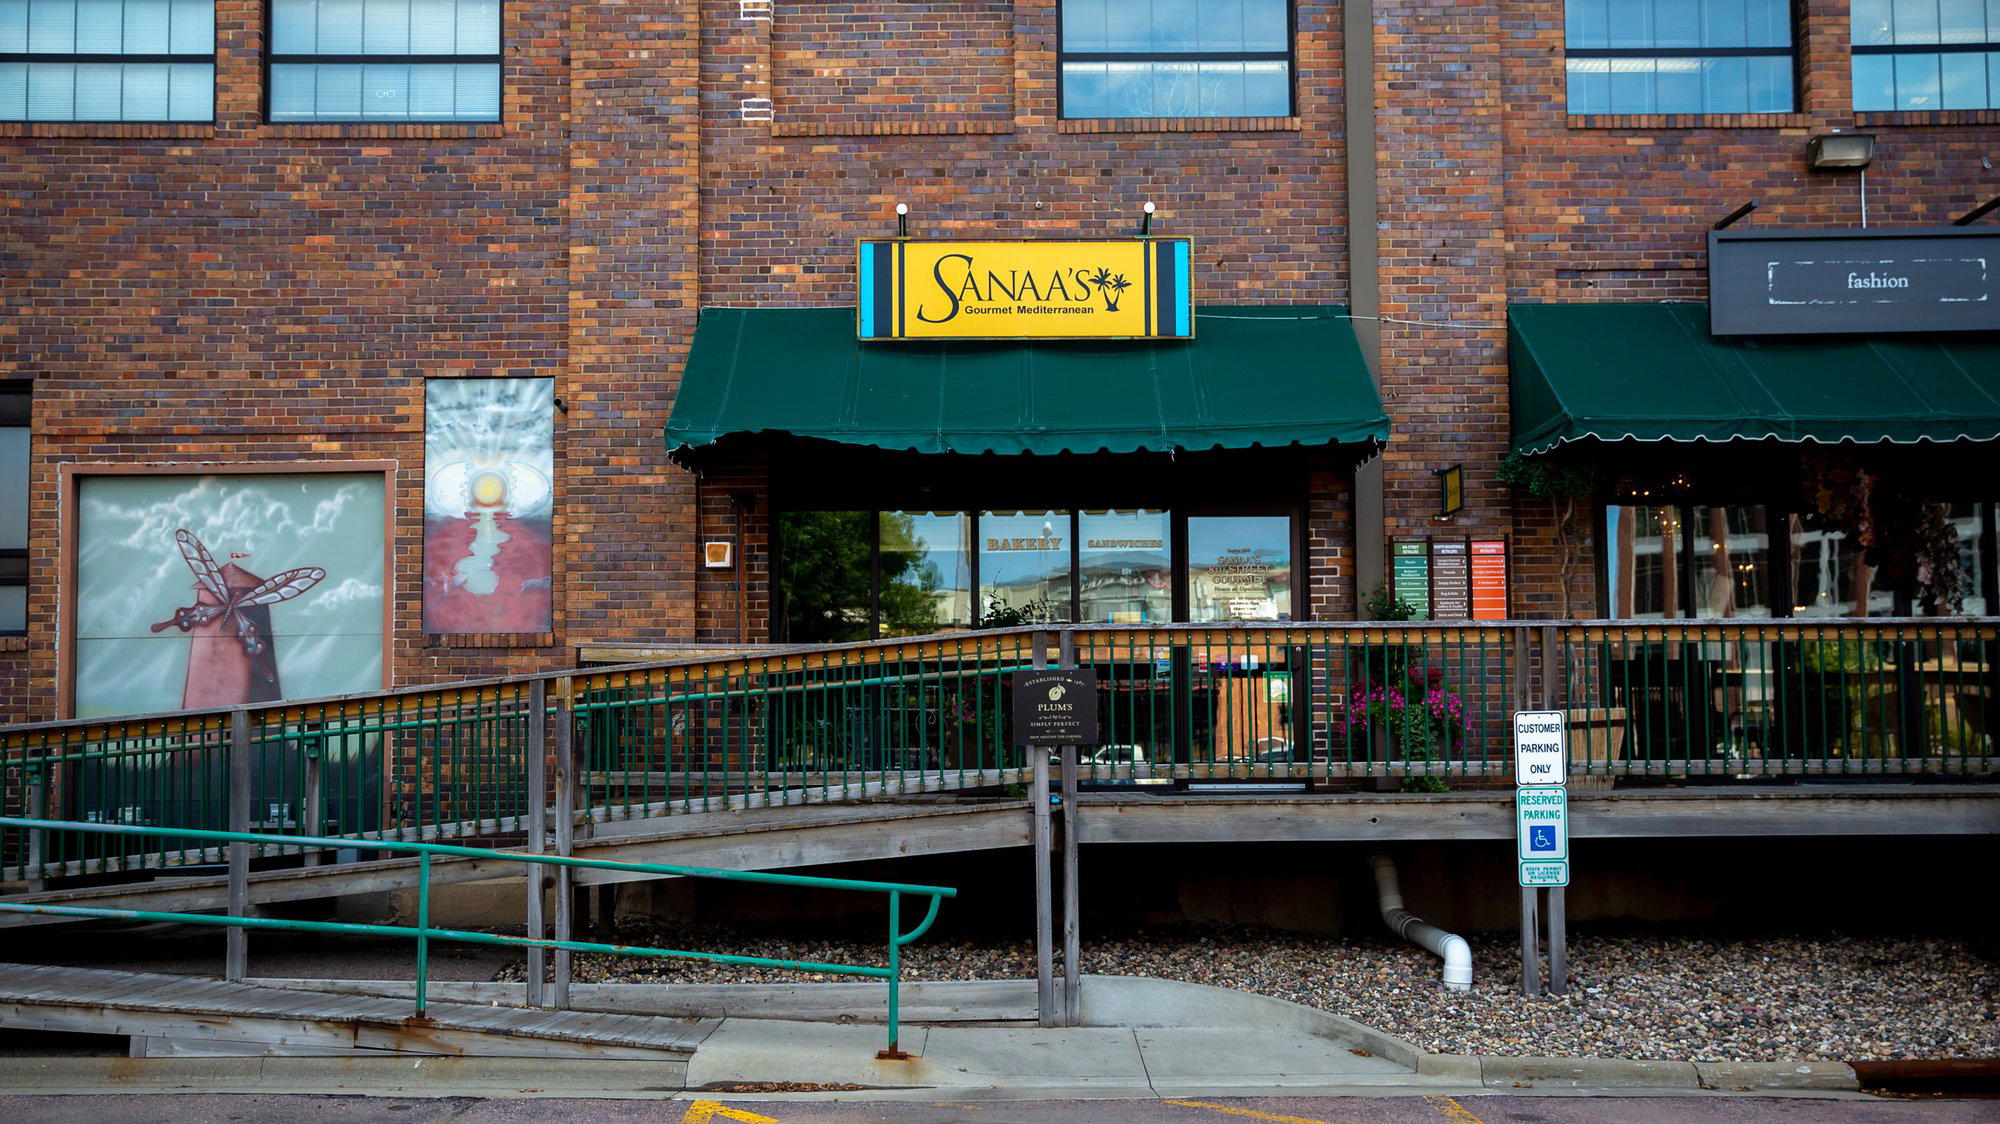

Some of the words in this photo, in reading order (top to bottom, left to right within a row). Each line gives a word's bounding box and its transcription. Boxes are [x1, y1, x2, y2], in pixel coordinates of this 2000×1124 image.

[1847, 272, 1909, 289] fashion
[917, 253, 1091, 324] SANAA'S
[964, 305, 1013, 315] Gourmet
[1016, 305, 1094, 315] Mediterranean
[987, 537, 1062, 551] BAKERY
[1087, 539, 1164, 549] SANDWICHES
[1025, 676, 1065, 687] ESTABLISHED
[1038, 703, 1073, 712] PLUM'S
[1518, 723, 1561, 734] CUSTOMER
[1520, 743, 1560, 753] PARKING
[1530, 764, 1552, 774] ONLY
[1520, 795, 1563, 805] RESERVED
[1523, 809, 1561, 820] PARKING
